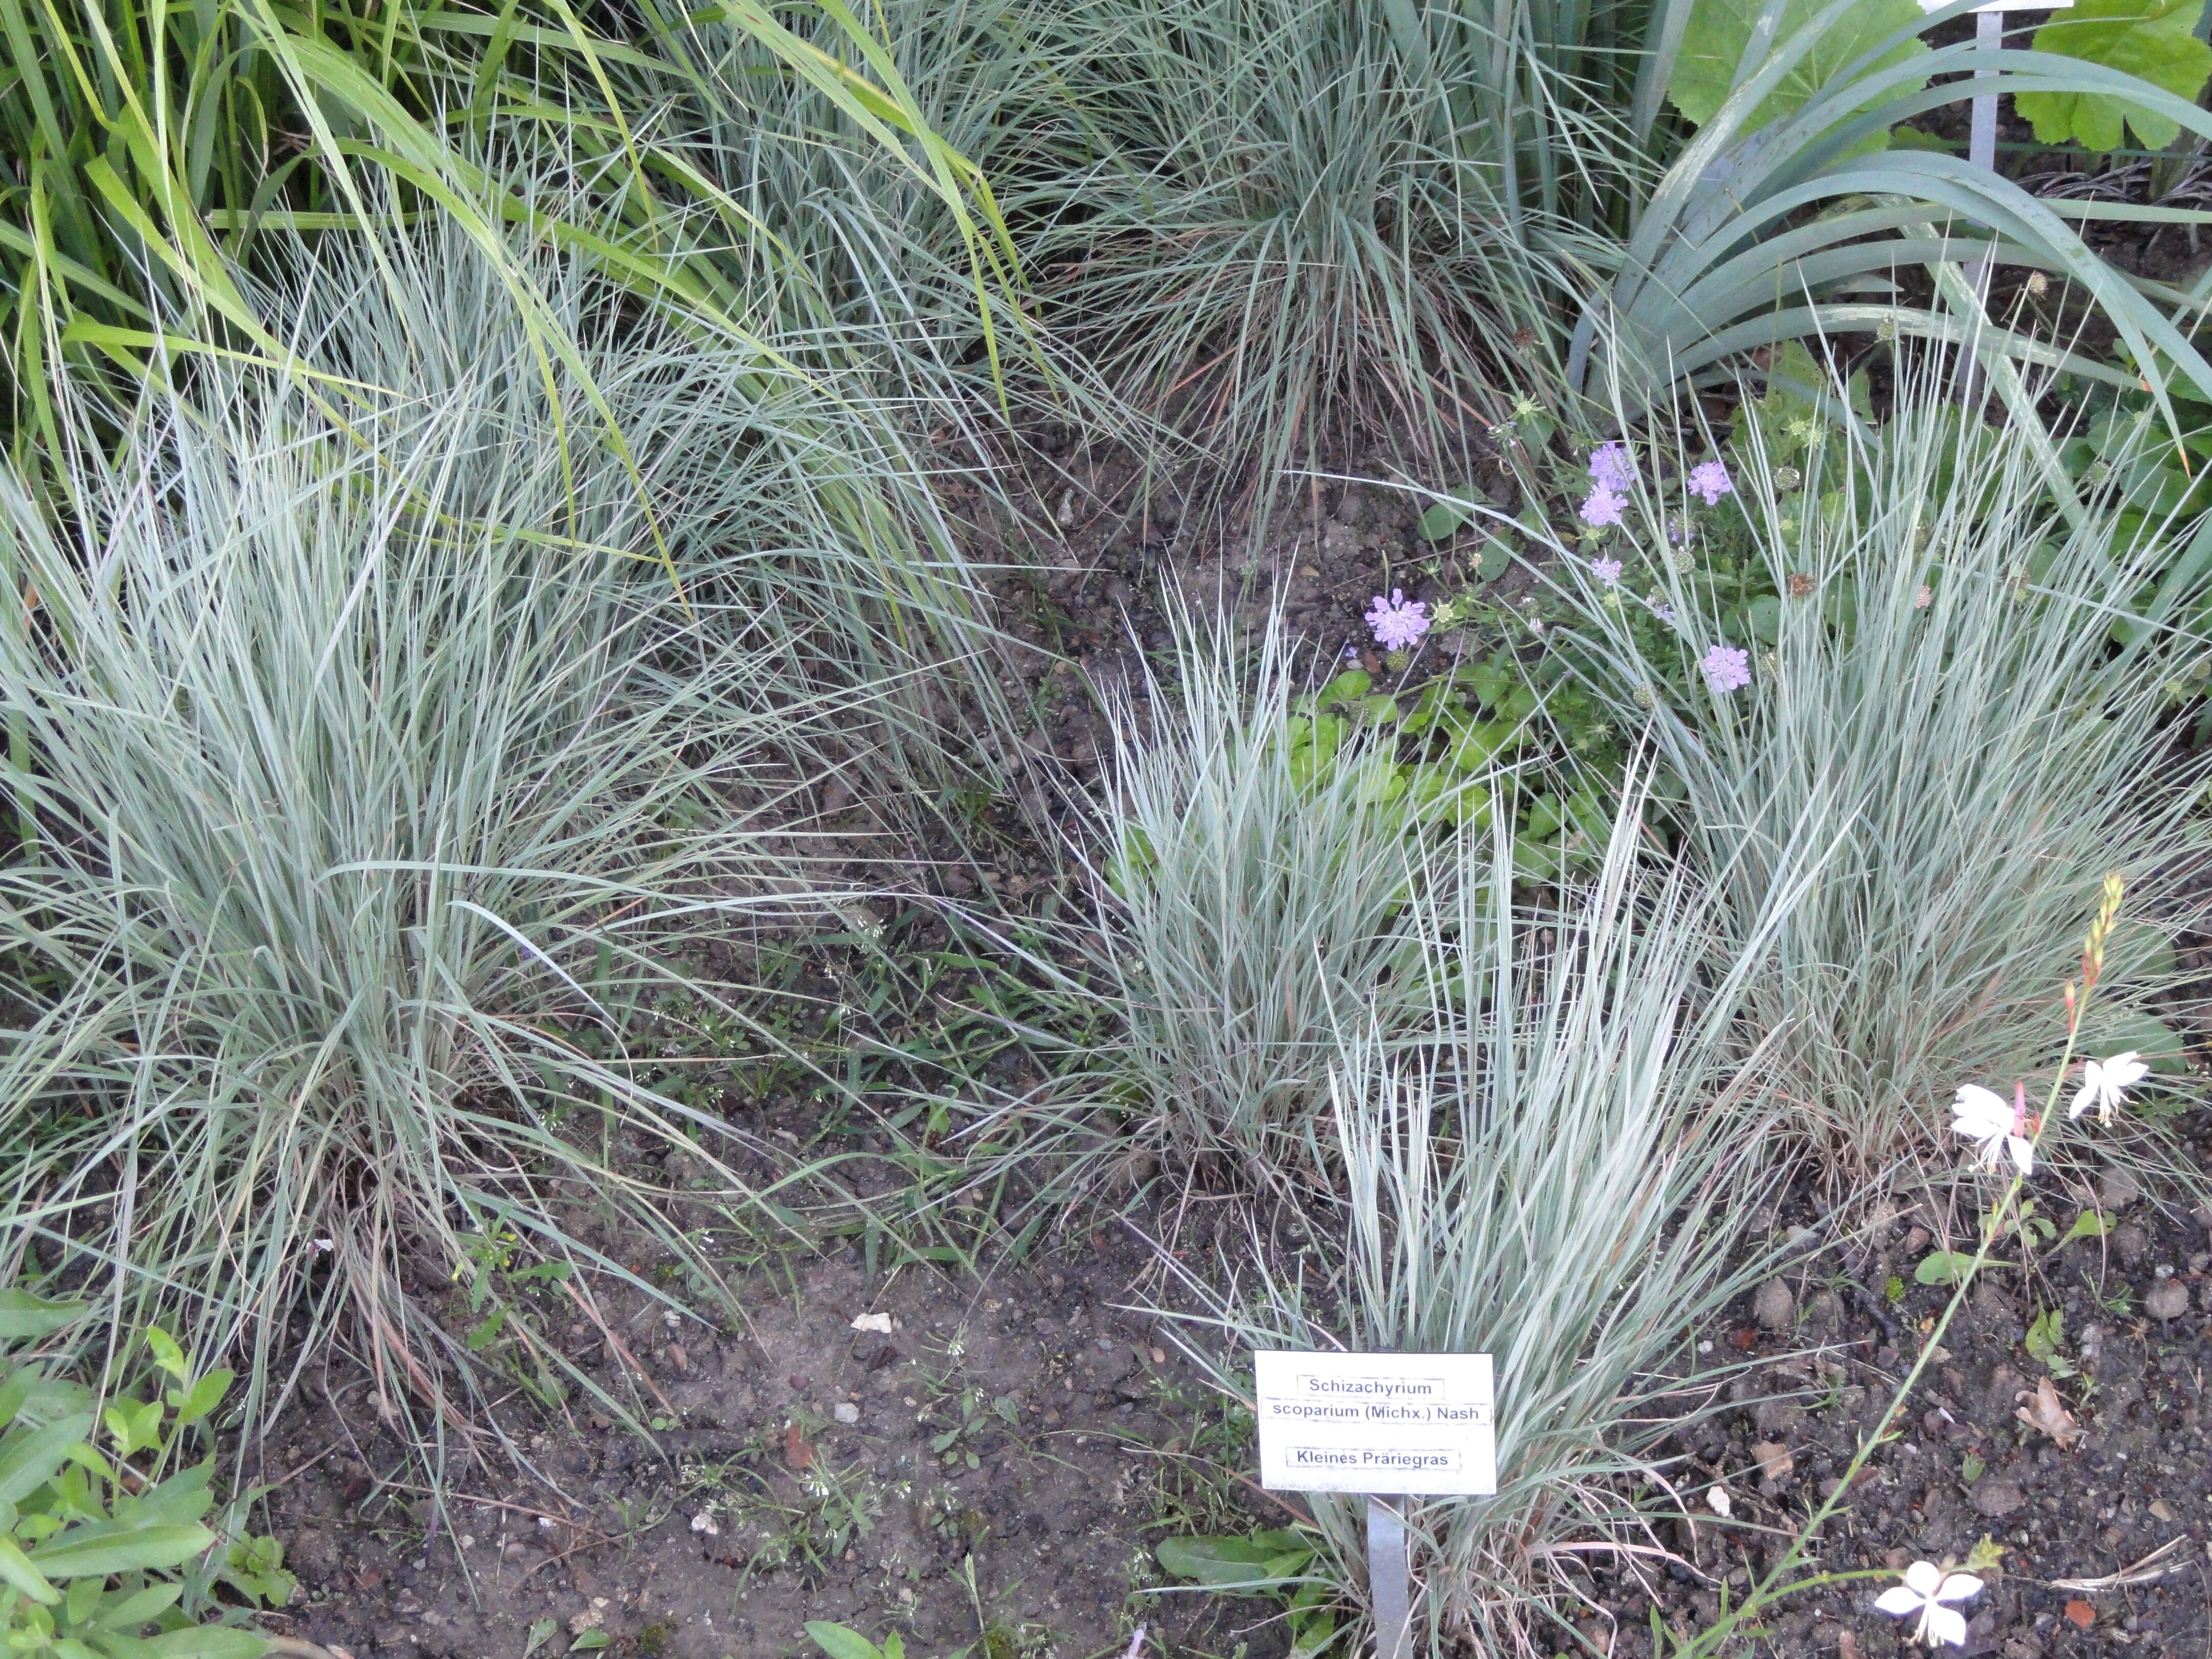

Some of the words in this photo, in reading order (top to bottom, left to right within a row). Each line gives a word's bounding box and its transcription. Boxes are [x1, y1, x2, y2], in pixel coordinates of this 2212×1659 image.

[1309, 1378, 1432, 1397] Schizachyrium
[1272, 1404, 1359, 1418] scoparium
[1365, 1405, 1431, 1421] (Michx.)
[1437, 1407, 1479, 1419] Nash
[1296, 1450, 1357, 1464] Kleines
[1363, 1452, 1449, 1468] Präriegras
